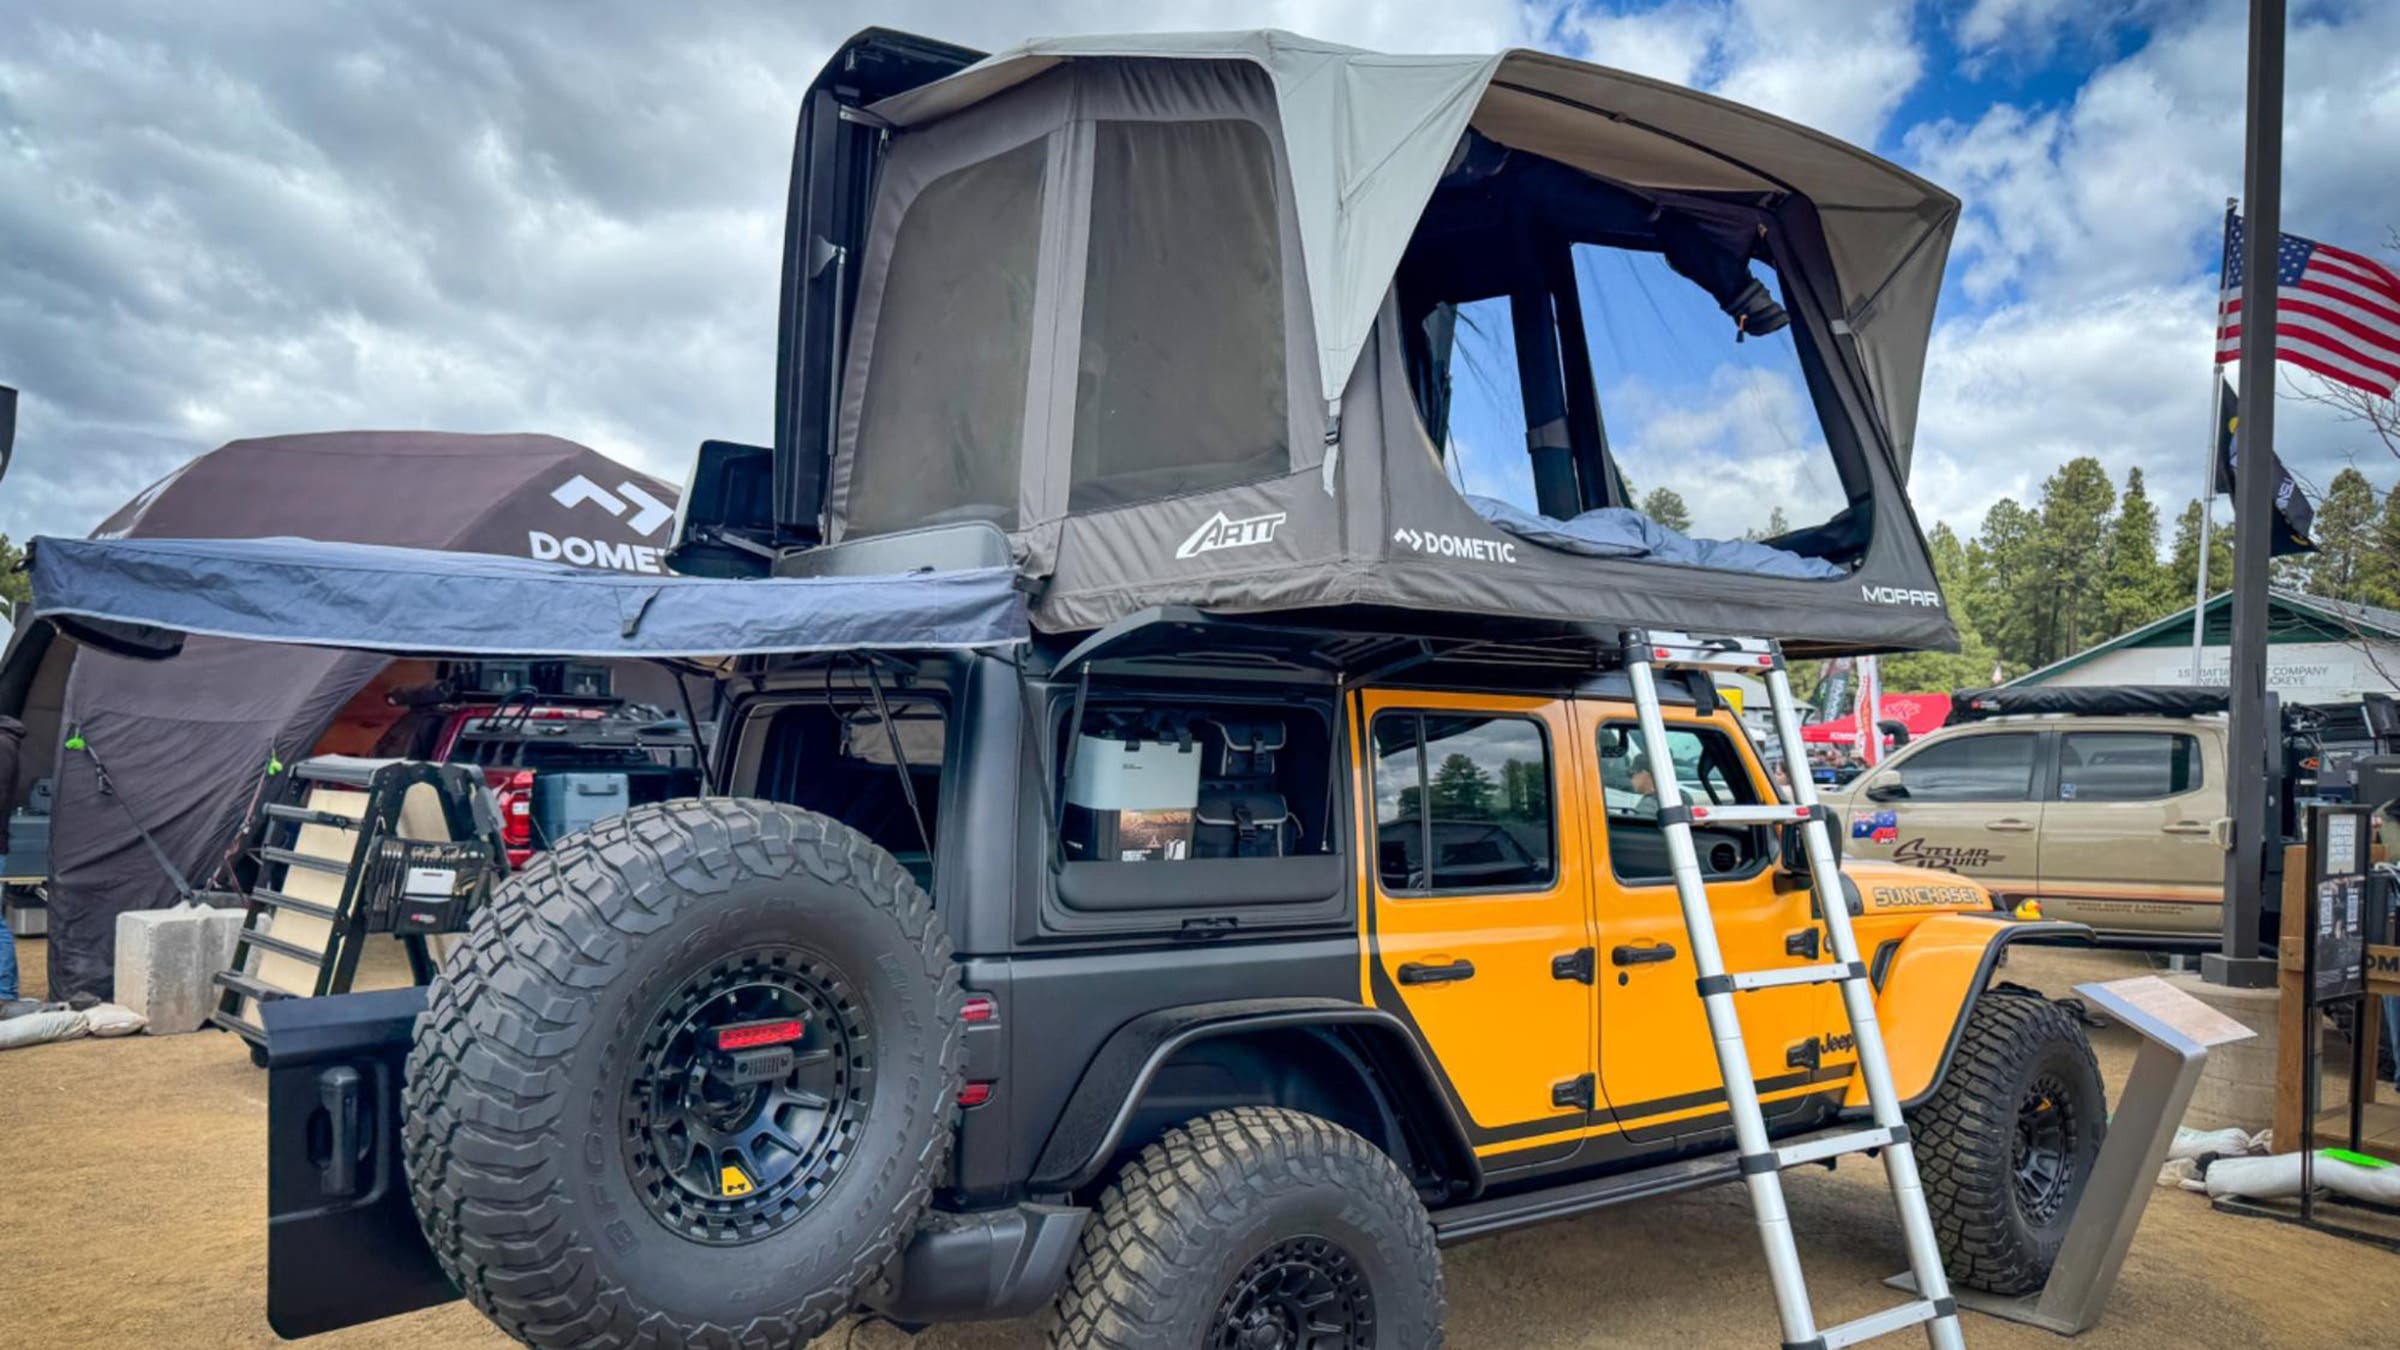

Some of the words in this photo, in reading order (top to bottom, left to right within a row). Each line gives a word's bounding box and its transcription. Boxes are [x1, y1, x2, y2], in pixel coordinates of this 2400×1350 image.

[528, 530, 681, 576] DOME
[1423, 531, 1517, 563] DOMETIC
[1861, 584, 1940, 608] MOPAR
[2272, 666, 2330, 677] COMPANY
[1893, 837, 1991, 862] STELLAR
[1874, 886, 1983, 907] SUNCHASER
[1821, 1032, 1855, 1054] Jeep
